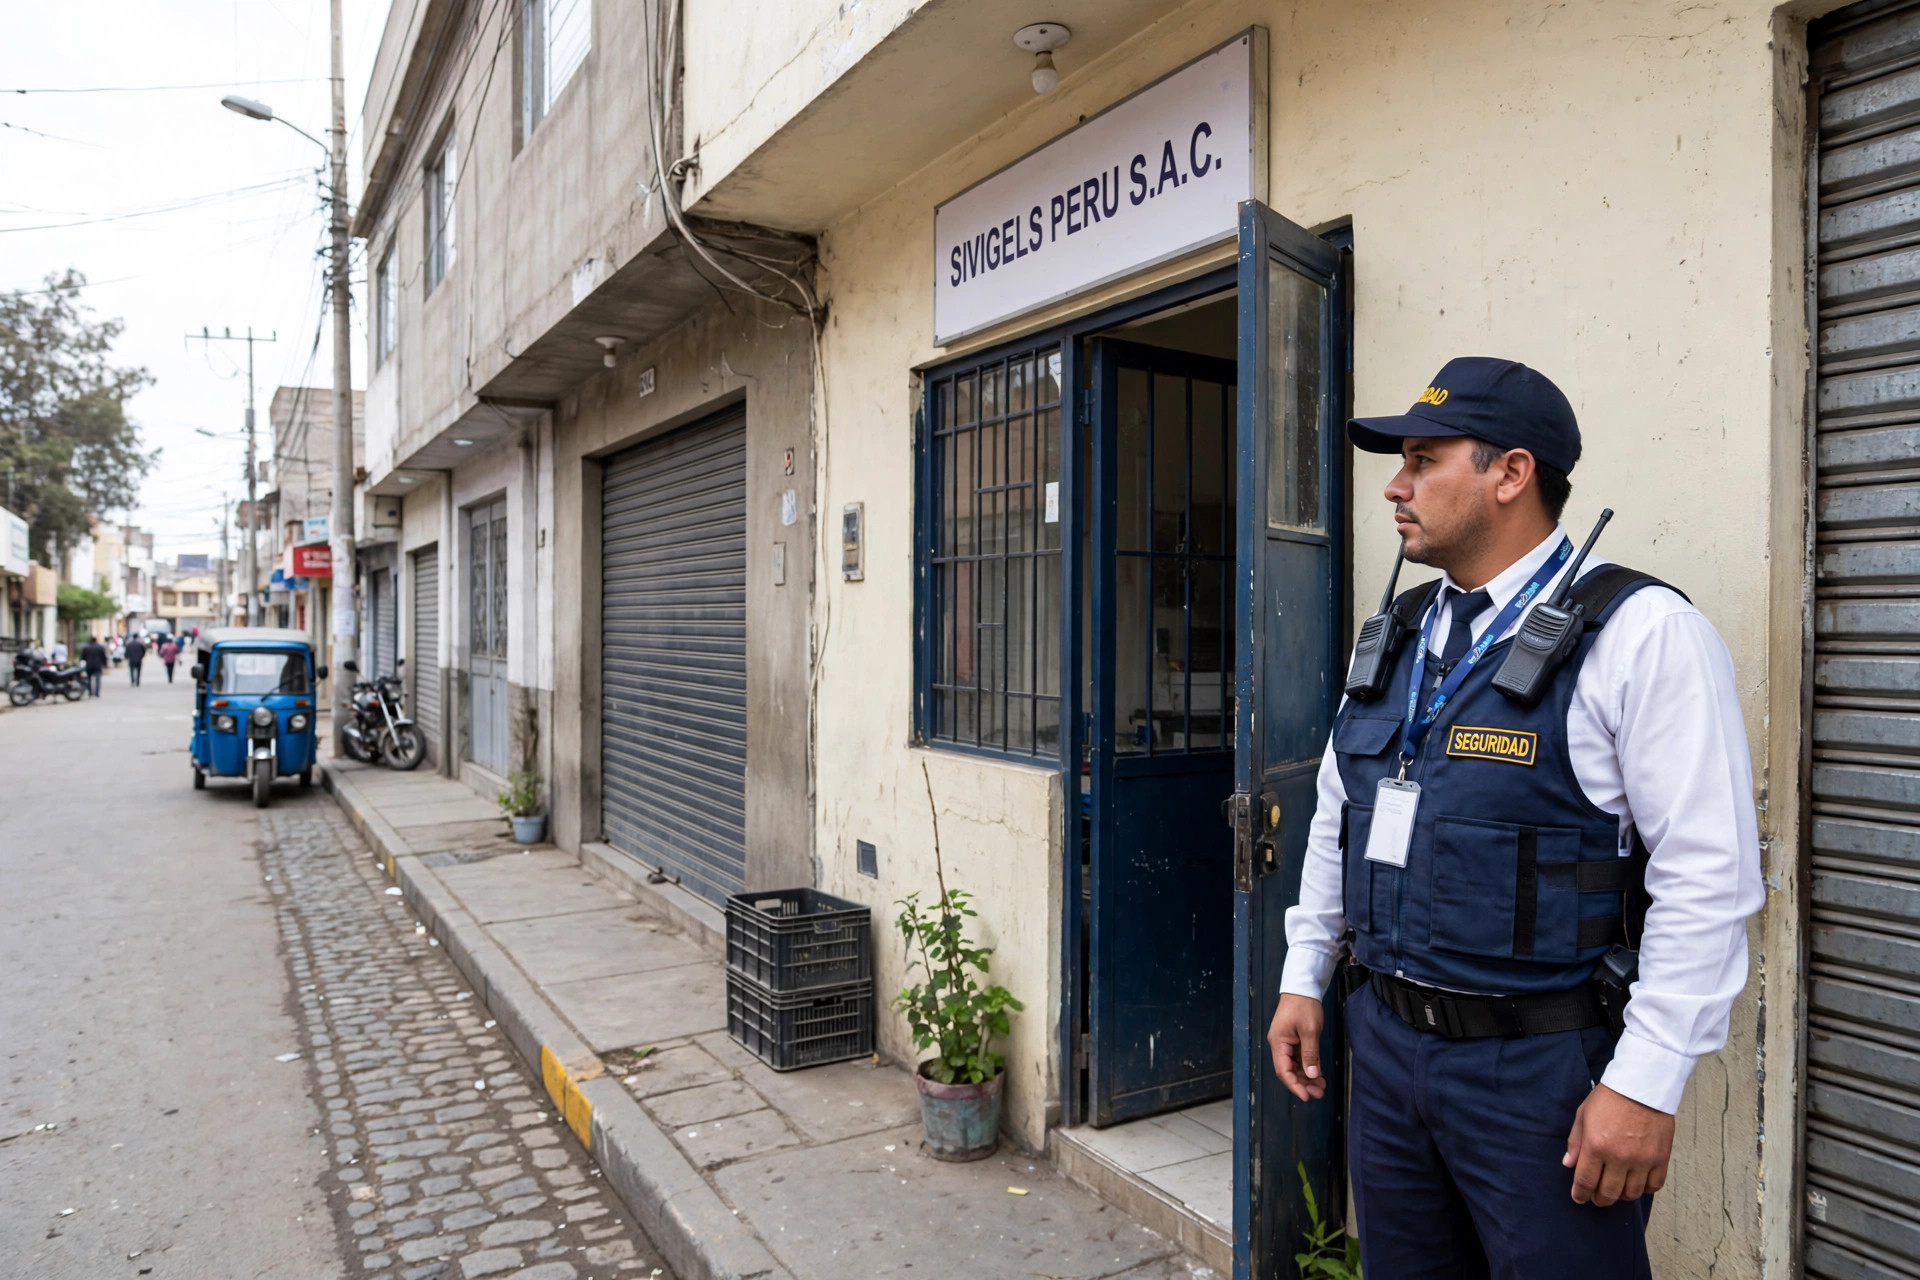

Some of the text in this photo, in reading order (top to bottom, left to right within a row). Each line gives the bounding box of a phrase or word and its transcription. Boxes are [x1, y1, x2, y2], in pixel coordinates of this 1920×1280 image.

[950, 121, 1222, 287] SIVIGELS PERU S.A.C.
[1454, 732, 1530, 757] SEGURIDAD
